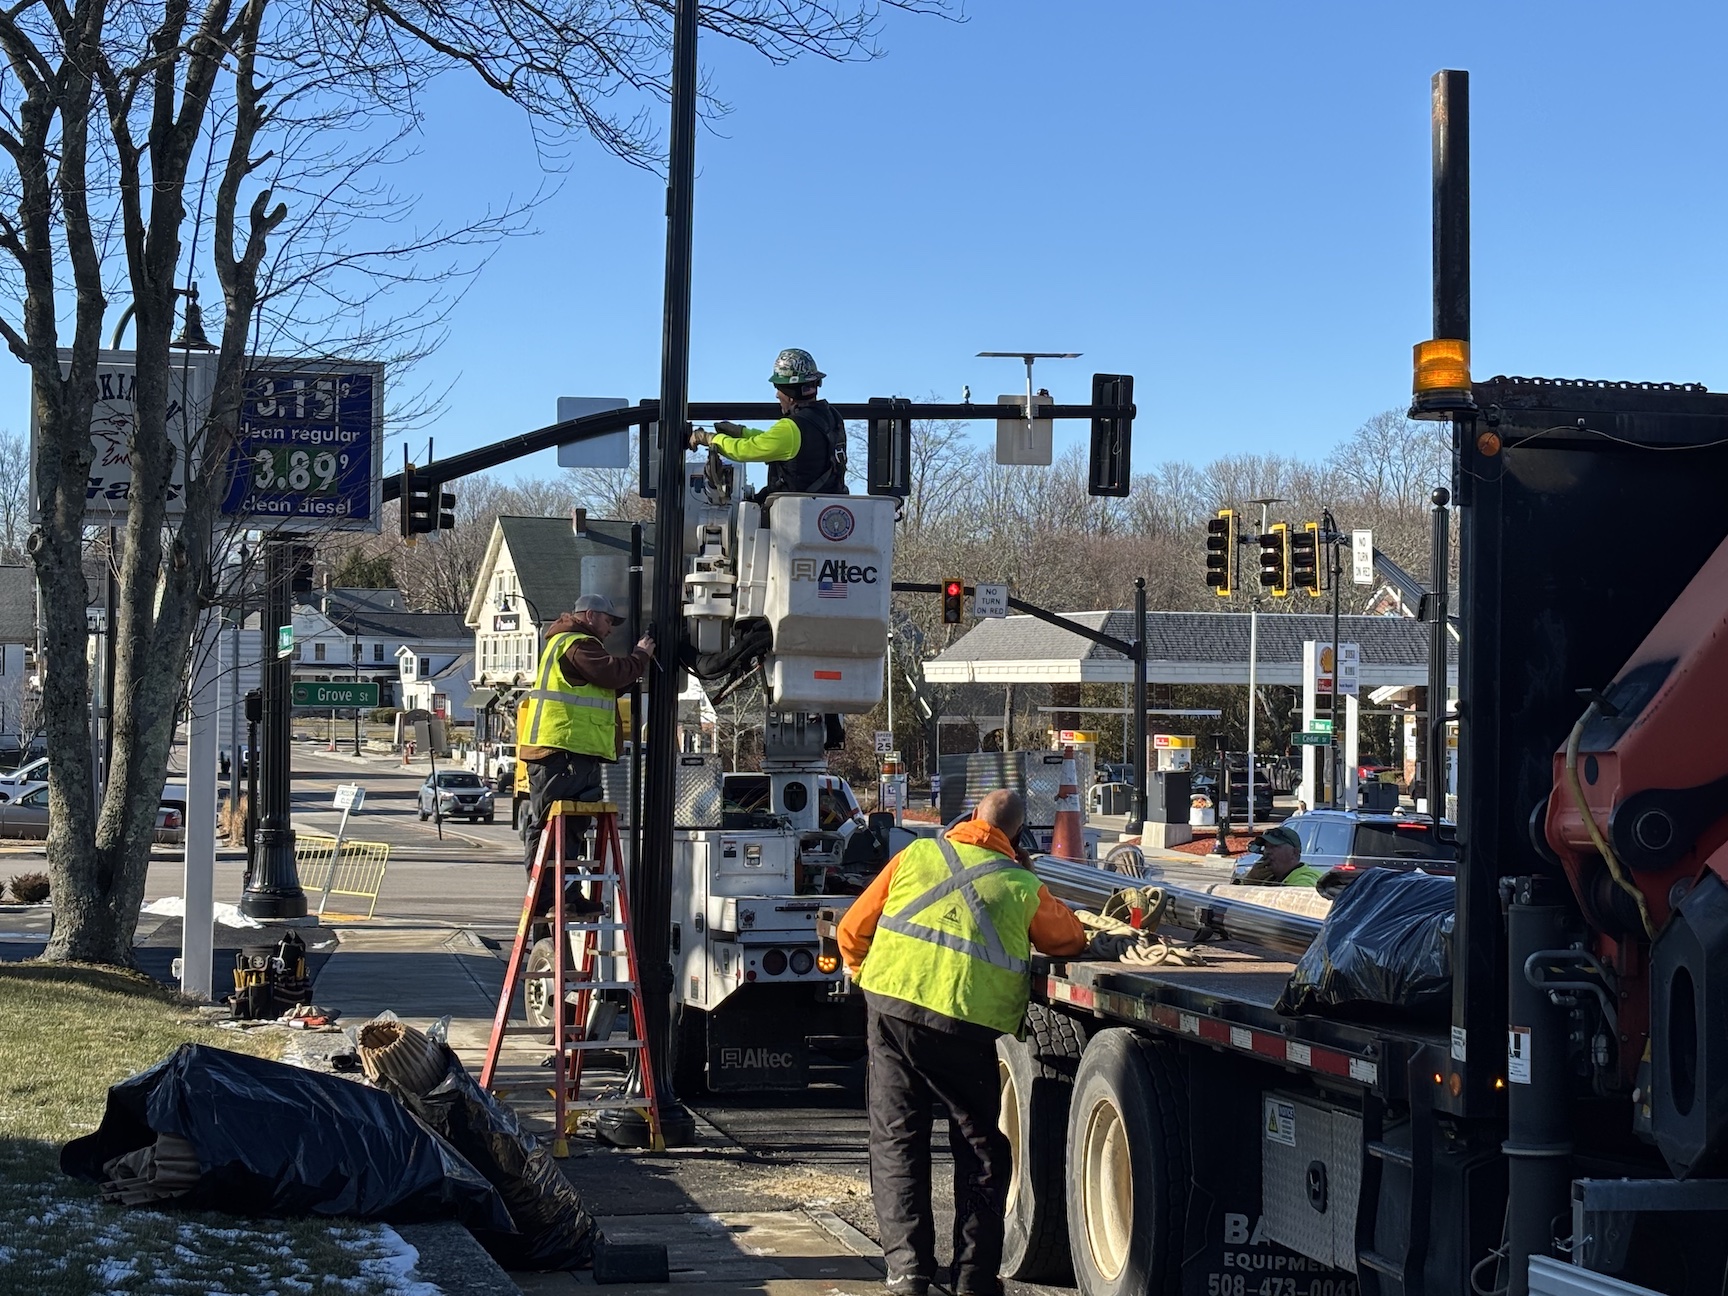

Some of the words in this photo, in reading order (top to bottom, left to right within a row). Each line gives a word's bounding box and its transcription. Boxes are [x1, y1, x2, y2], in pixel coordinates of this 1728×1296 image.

[292, 425, 360, 444] regular
[255, 449, 337, 491] 3.89
[242, 495, 291, 513] clean
[298, 498, 352, 515] diesel
[1358, 537, 1367, 547] NO
[817, 559, 878, 584] Altec
[985, 588, 998, 596] NO
[989, 607, 1004, 615] RED
[317, 687, 353, 702] Grove
[359, 691, 369, 702] St
[877, 742, 892, 752] 25
[1302, 735, 1319, 743] Cedar
[742, 1047, 794, 1069] Altec
[1223, 1251, 1336, 1273] EQUIPME
